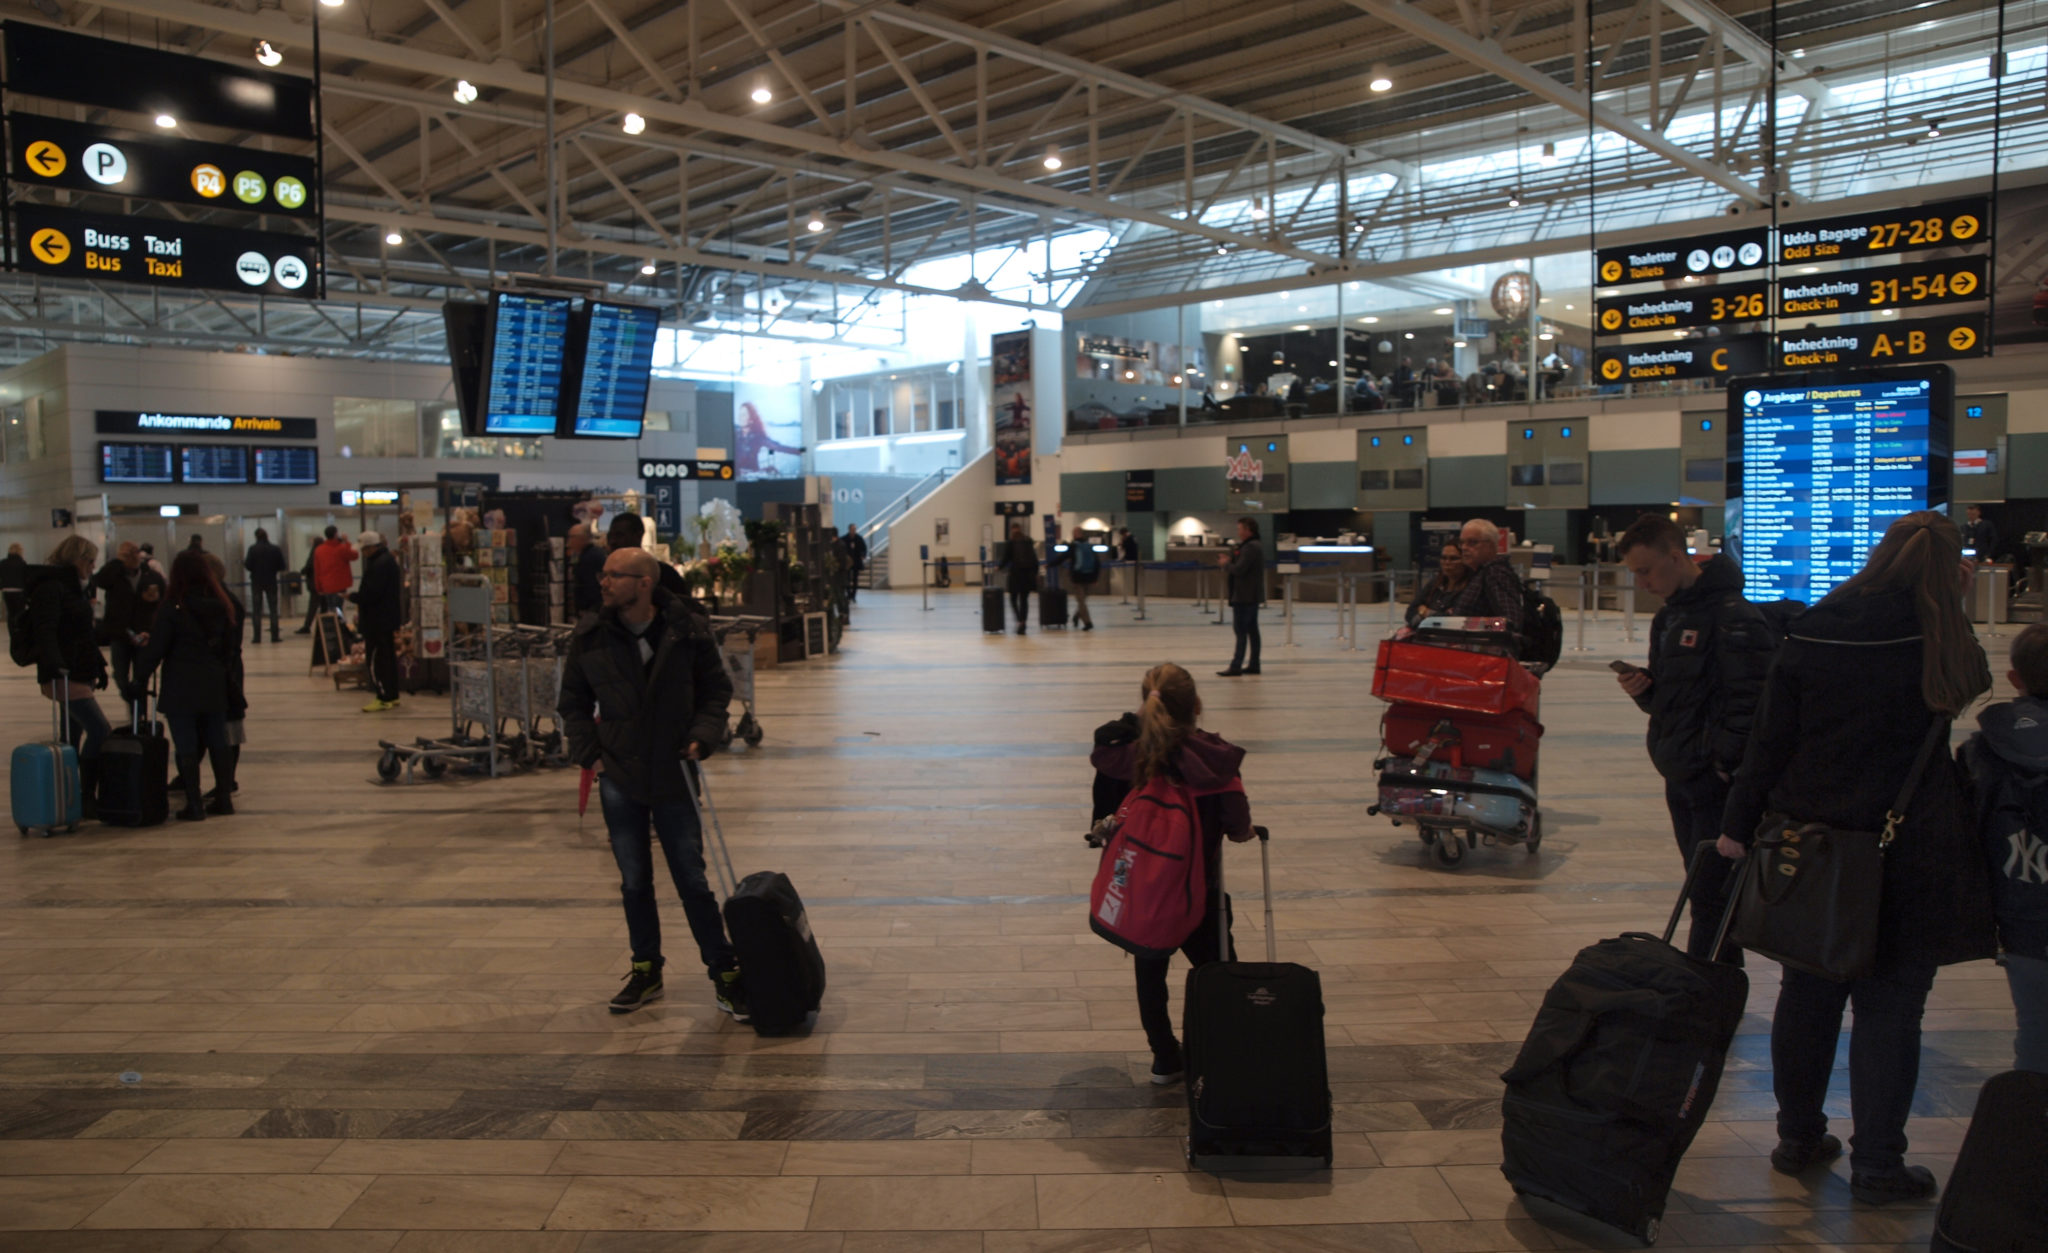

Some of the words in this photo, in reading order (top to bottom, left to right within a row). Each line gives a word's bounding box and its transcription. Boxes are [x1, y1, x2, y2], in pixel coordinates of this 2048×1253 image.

[98, 151, 114, 176] P
[196, 175, 221, 194] P4
[238, 177, 262, 197] P5
[278, 182, 301, 203] P6
[84, 229, 130, 250] Buss
[144, 235, 182, 256] Taxi
[1784, 231, 1815, 247] Udda
[1818, 225, 1867, 245] Bagage
[1868, 217, 1943, 250] 27-28
[1629, 249, 1677, 266] Toaletter
[1784, 244, 1811, 260] Odd
[1814, 242, 1840, 258] Size
[85, 252, 121, 271] Bus
[145, 257, 183, 277] Taxi
[1629, 265, 1664, 279] Toilets
[1784, 280, 1859, 299] Incheckning
[1869, 274, 1947, 305] 31-54
[1629, 298, 1693, 317] Incheckning
[1711, 293, 1764, 321] 3-26
[1784, 297, 1839, 314] Check-in
[1629, 313, 1676, 329] Check-in
[1783, 335, 1859, 353] Incheckning
[1629, 349, 1693, 367] Incheckning
[1710, 348, 1729, 372] C
[1784, 351, 1839, 366] Check-in
[1629, 363, 1676, 379] Check-in
[1811, 390, 1862, 400] Departures
[138, 413, 231, 430] Ankommande
[233, 416, 282, 430] Arrivals
[1966, 407, 1982, 418] 12
[659, 488, 668, 502] P
